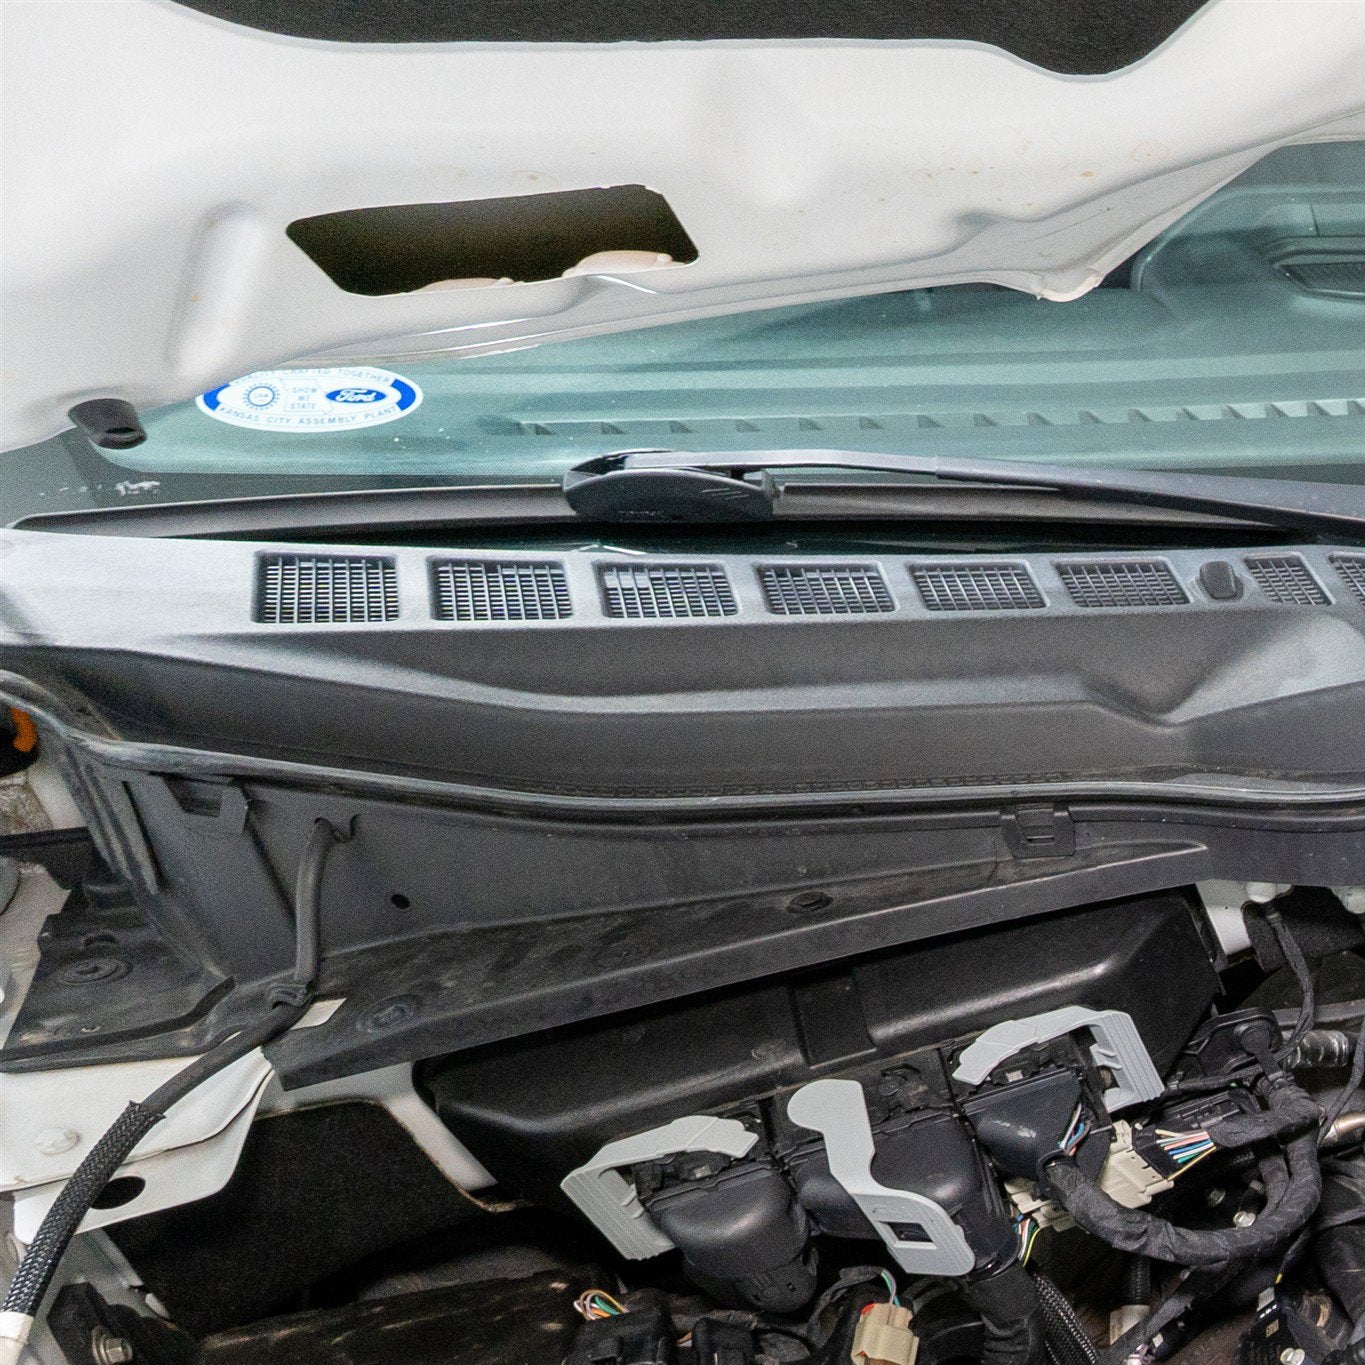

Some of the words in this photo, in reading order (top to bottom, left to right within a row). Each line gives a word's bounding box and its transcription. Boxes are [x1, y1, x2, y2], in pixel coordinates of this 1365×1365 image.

[220, 407, 260, 422] KANSAS
[267, 416, 291, 424] CITY
[299, 416, 356, 425] ASSEMBLY
[364, 407, 398, 419] PLANT
